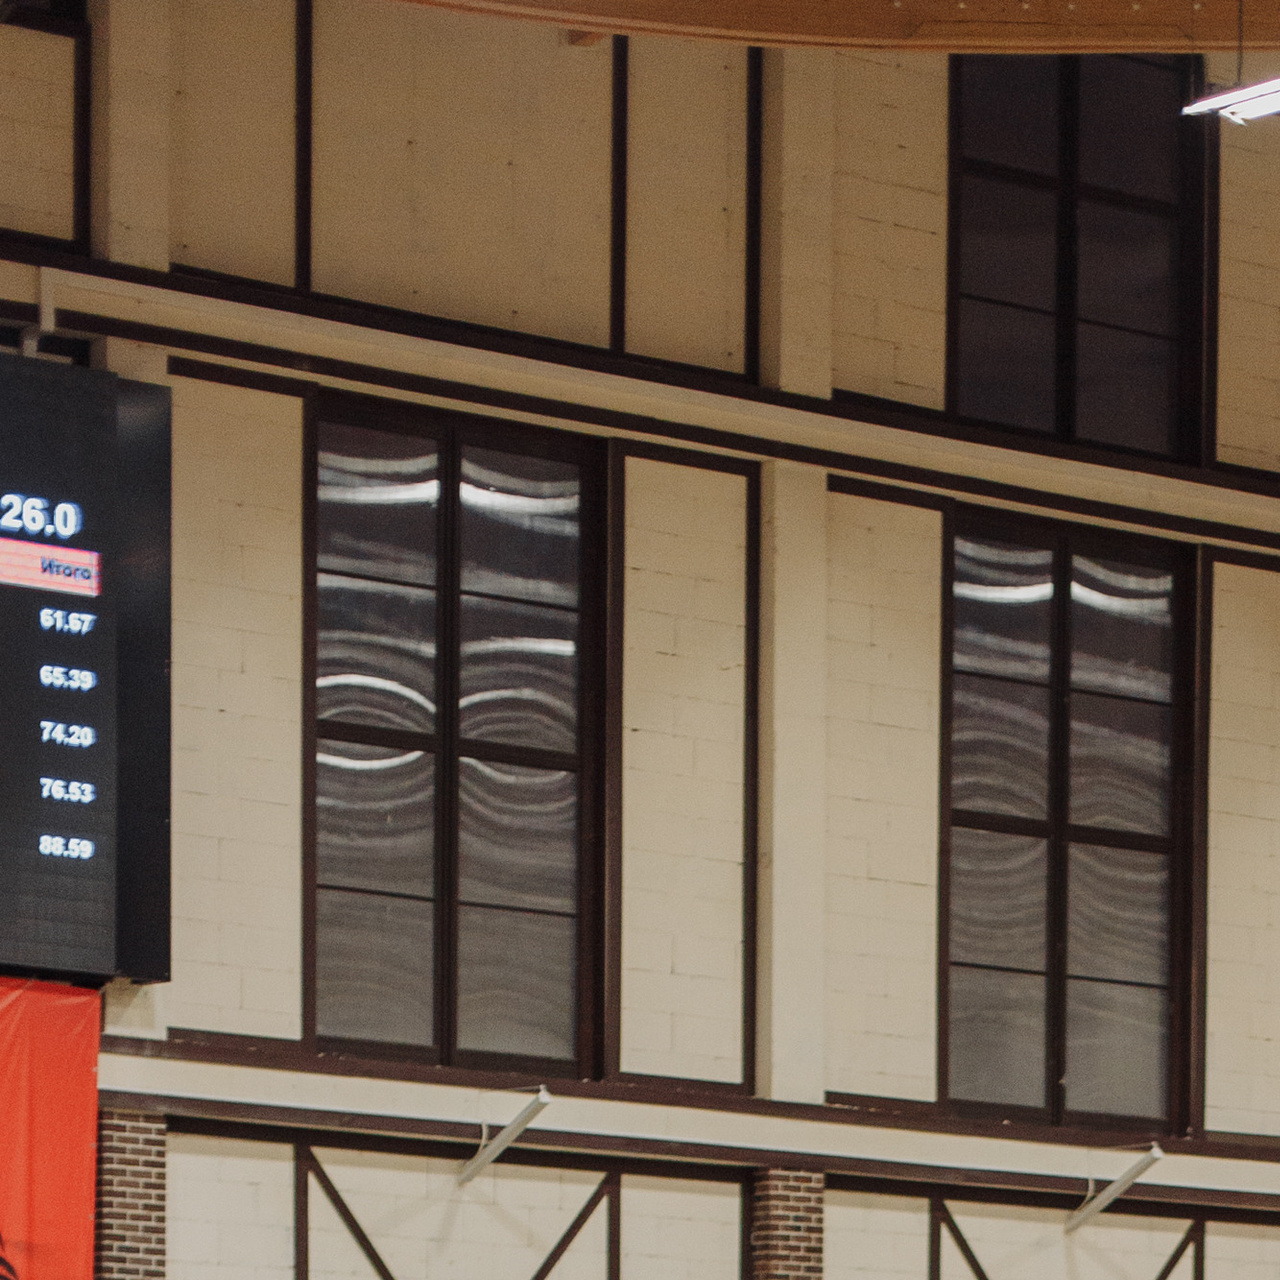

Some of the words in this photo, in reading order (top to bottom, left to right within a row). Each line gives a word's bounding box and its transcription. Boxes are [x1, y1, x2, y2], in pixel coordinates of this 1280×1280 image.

[0, 494, 80, 537] 26.0
[39, 608, 97, 634] 61.67
[39, 664, 97, 691] 65.39
[39, 720, 97, 747] 74.20
[39, 776, 97, 803] 76.53
